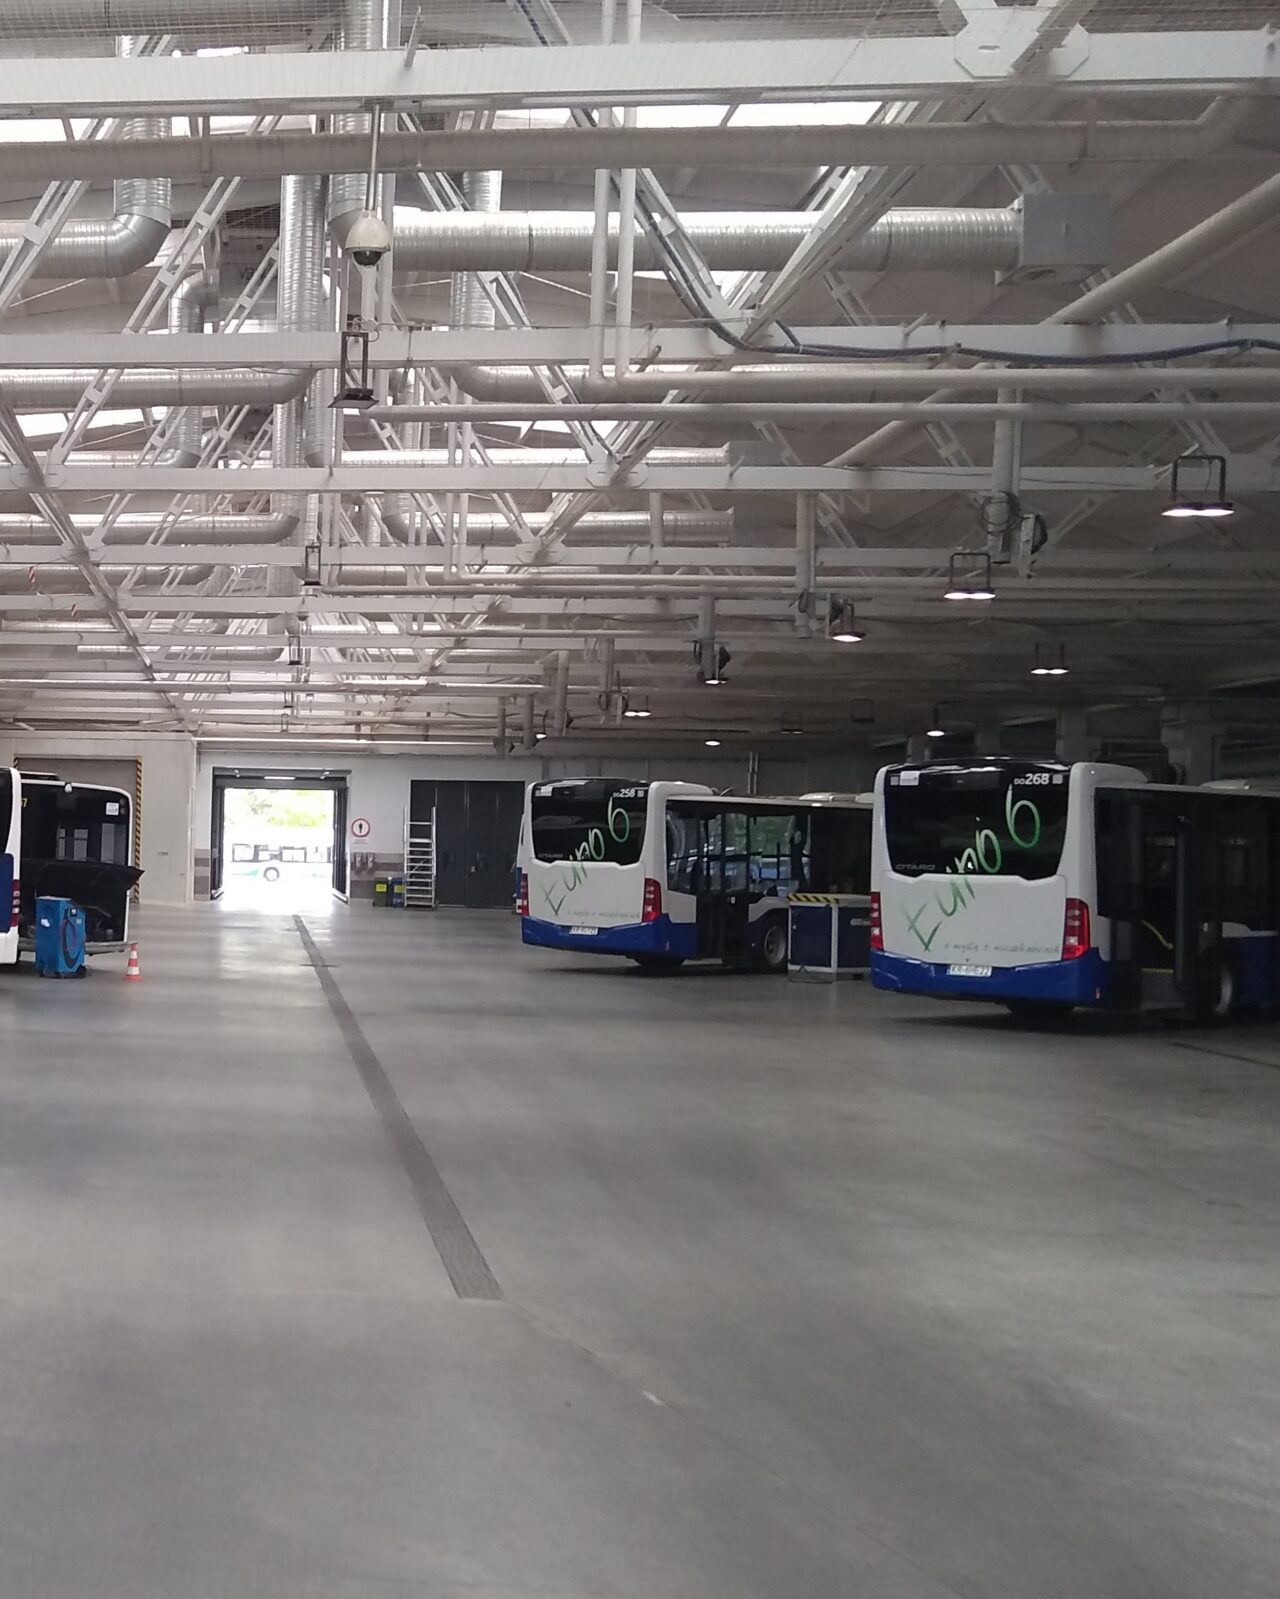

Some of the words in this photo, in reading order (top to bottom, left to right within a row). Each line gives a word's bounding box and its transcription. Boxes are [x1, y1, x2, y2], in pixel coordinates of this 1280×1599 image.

[539, 828, 605, 916] Euro
[607, 796, 630, 843] 6
[902, 829, 1002, 952] Euro
[1005, 784, 1041, 848] 6
